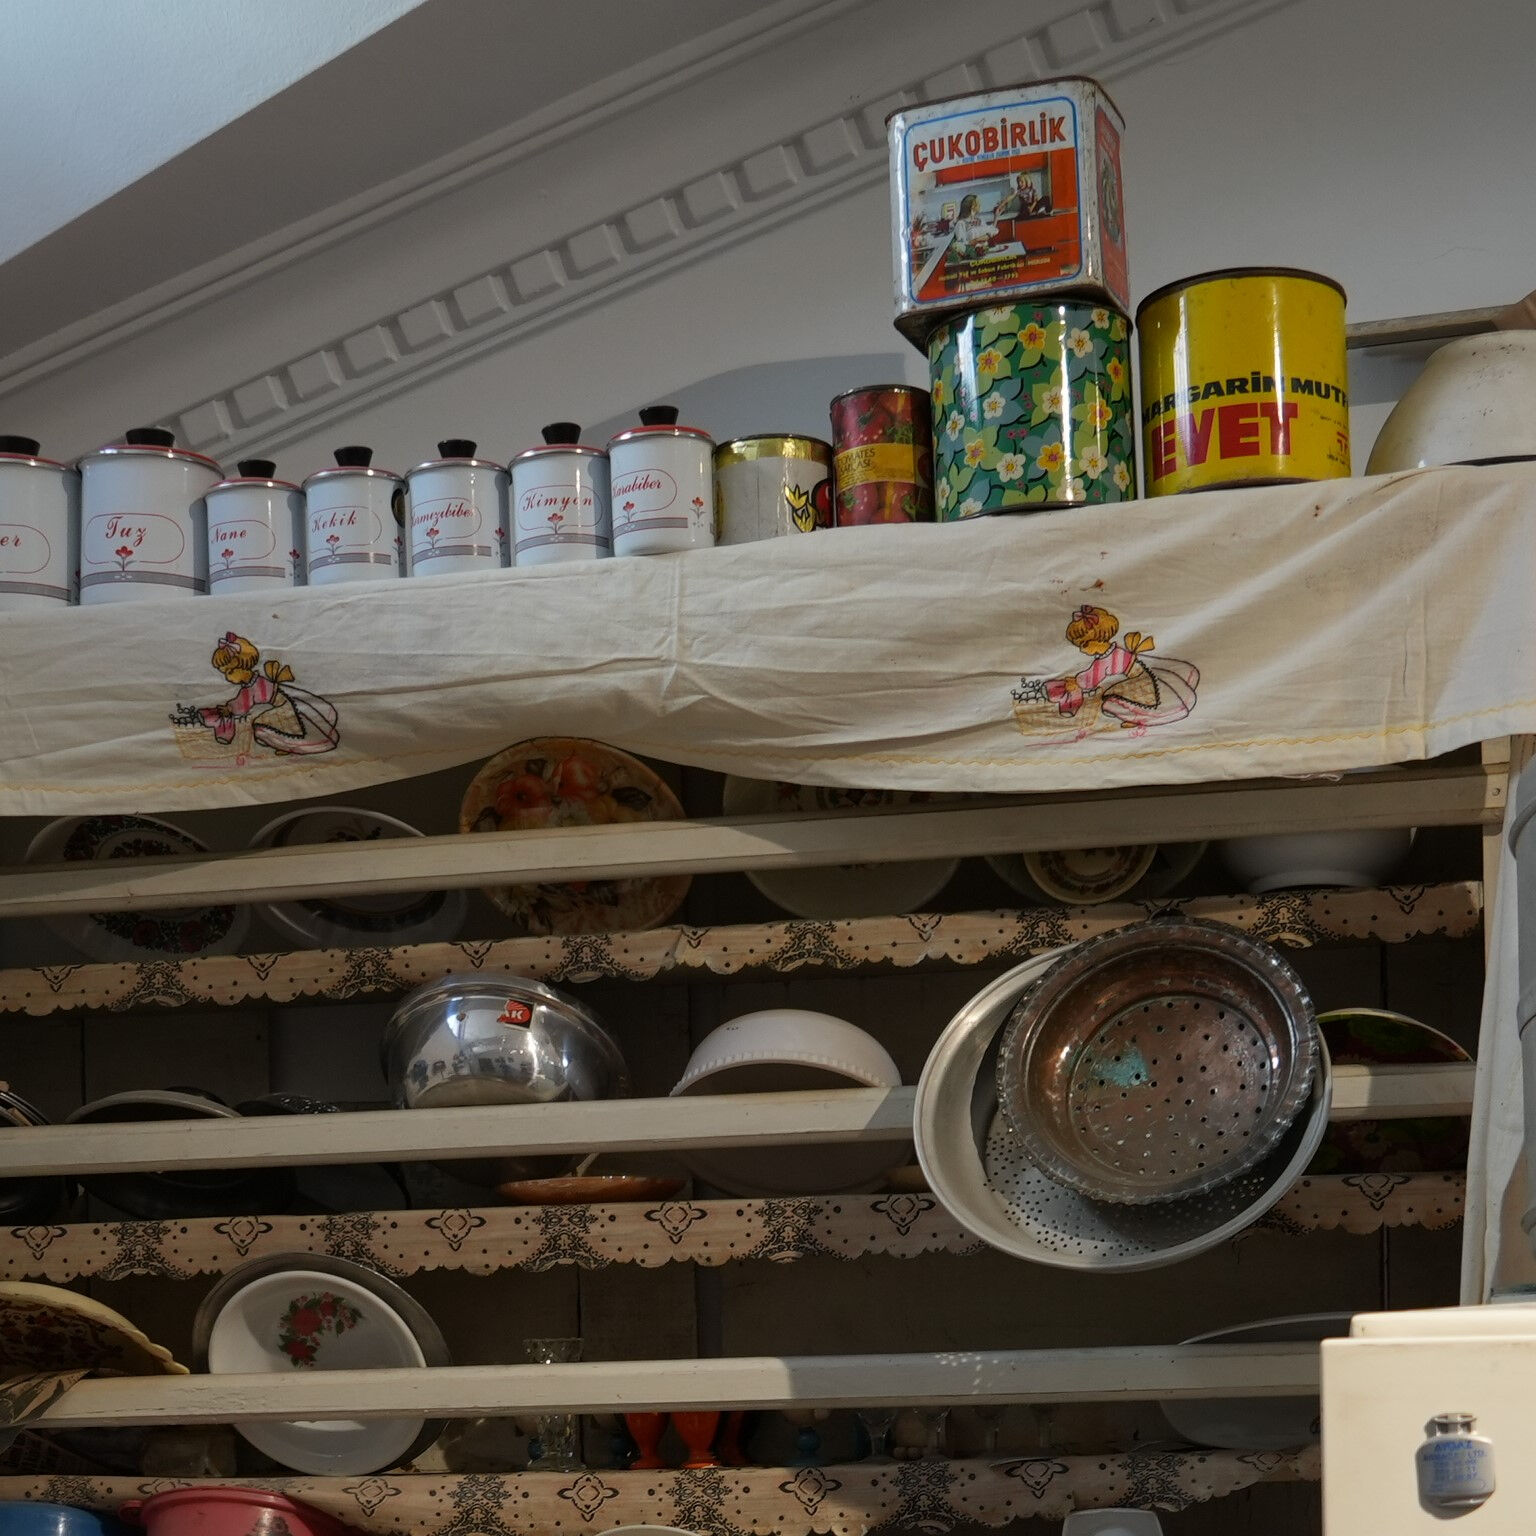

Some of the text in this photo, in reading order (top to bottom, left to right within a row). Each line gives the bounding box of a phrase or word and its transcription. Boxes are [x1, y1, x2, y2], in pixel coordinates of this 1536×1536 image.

[913, 111, 1067, 172] ÇUKOBİRLİK
[1151, 401, 1298, 482] EVET
[104, 514, 149, 547] Tuz
[208, 525, 248, 546] Nane
[311, 506, 359, 533] Kekik
